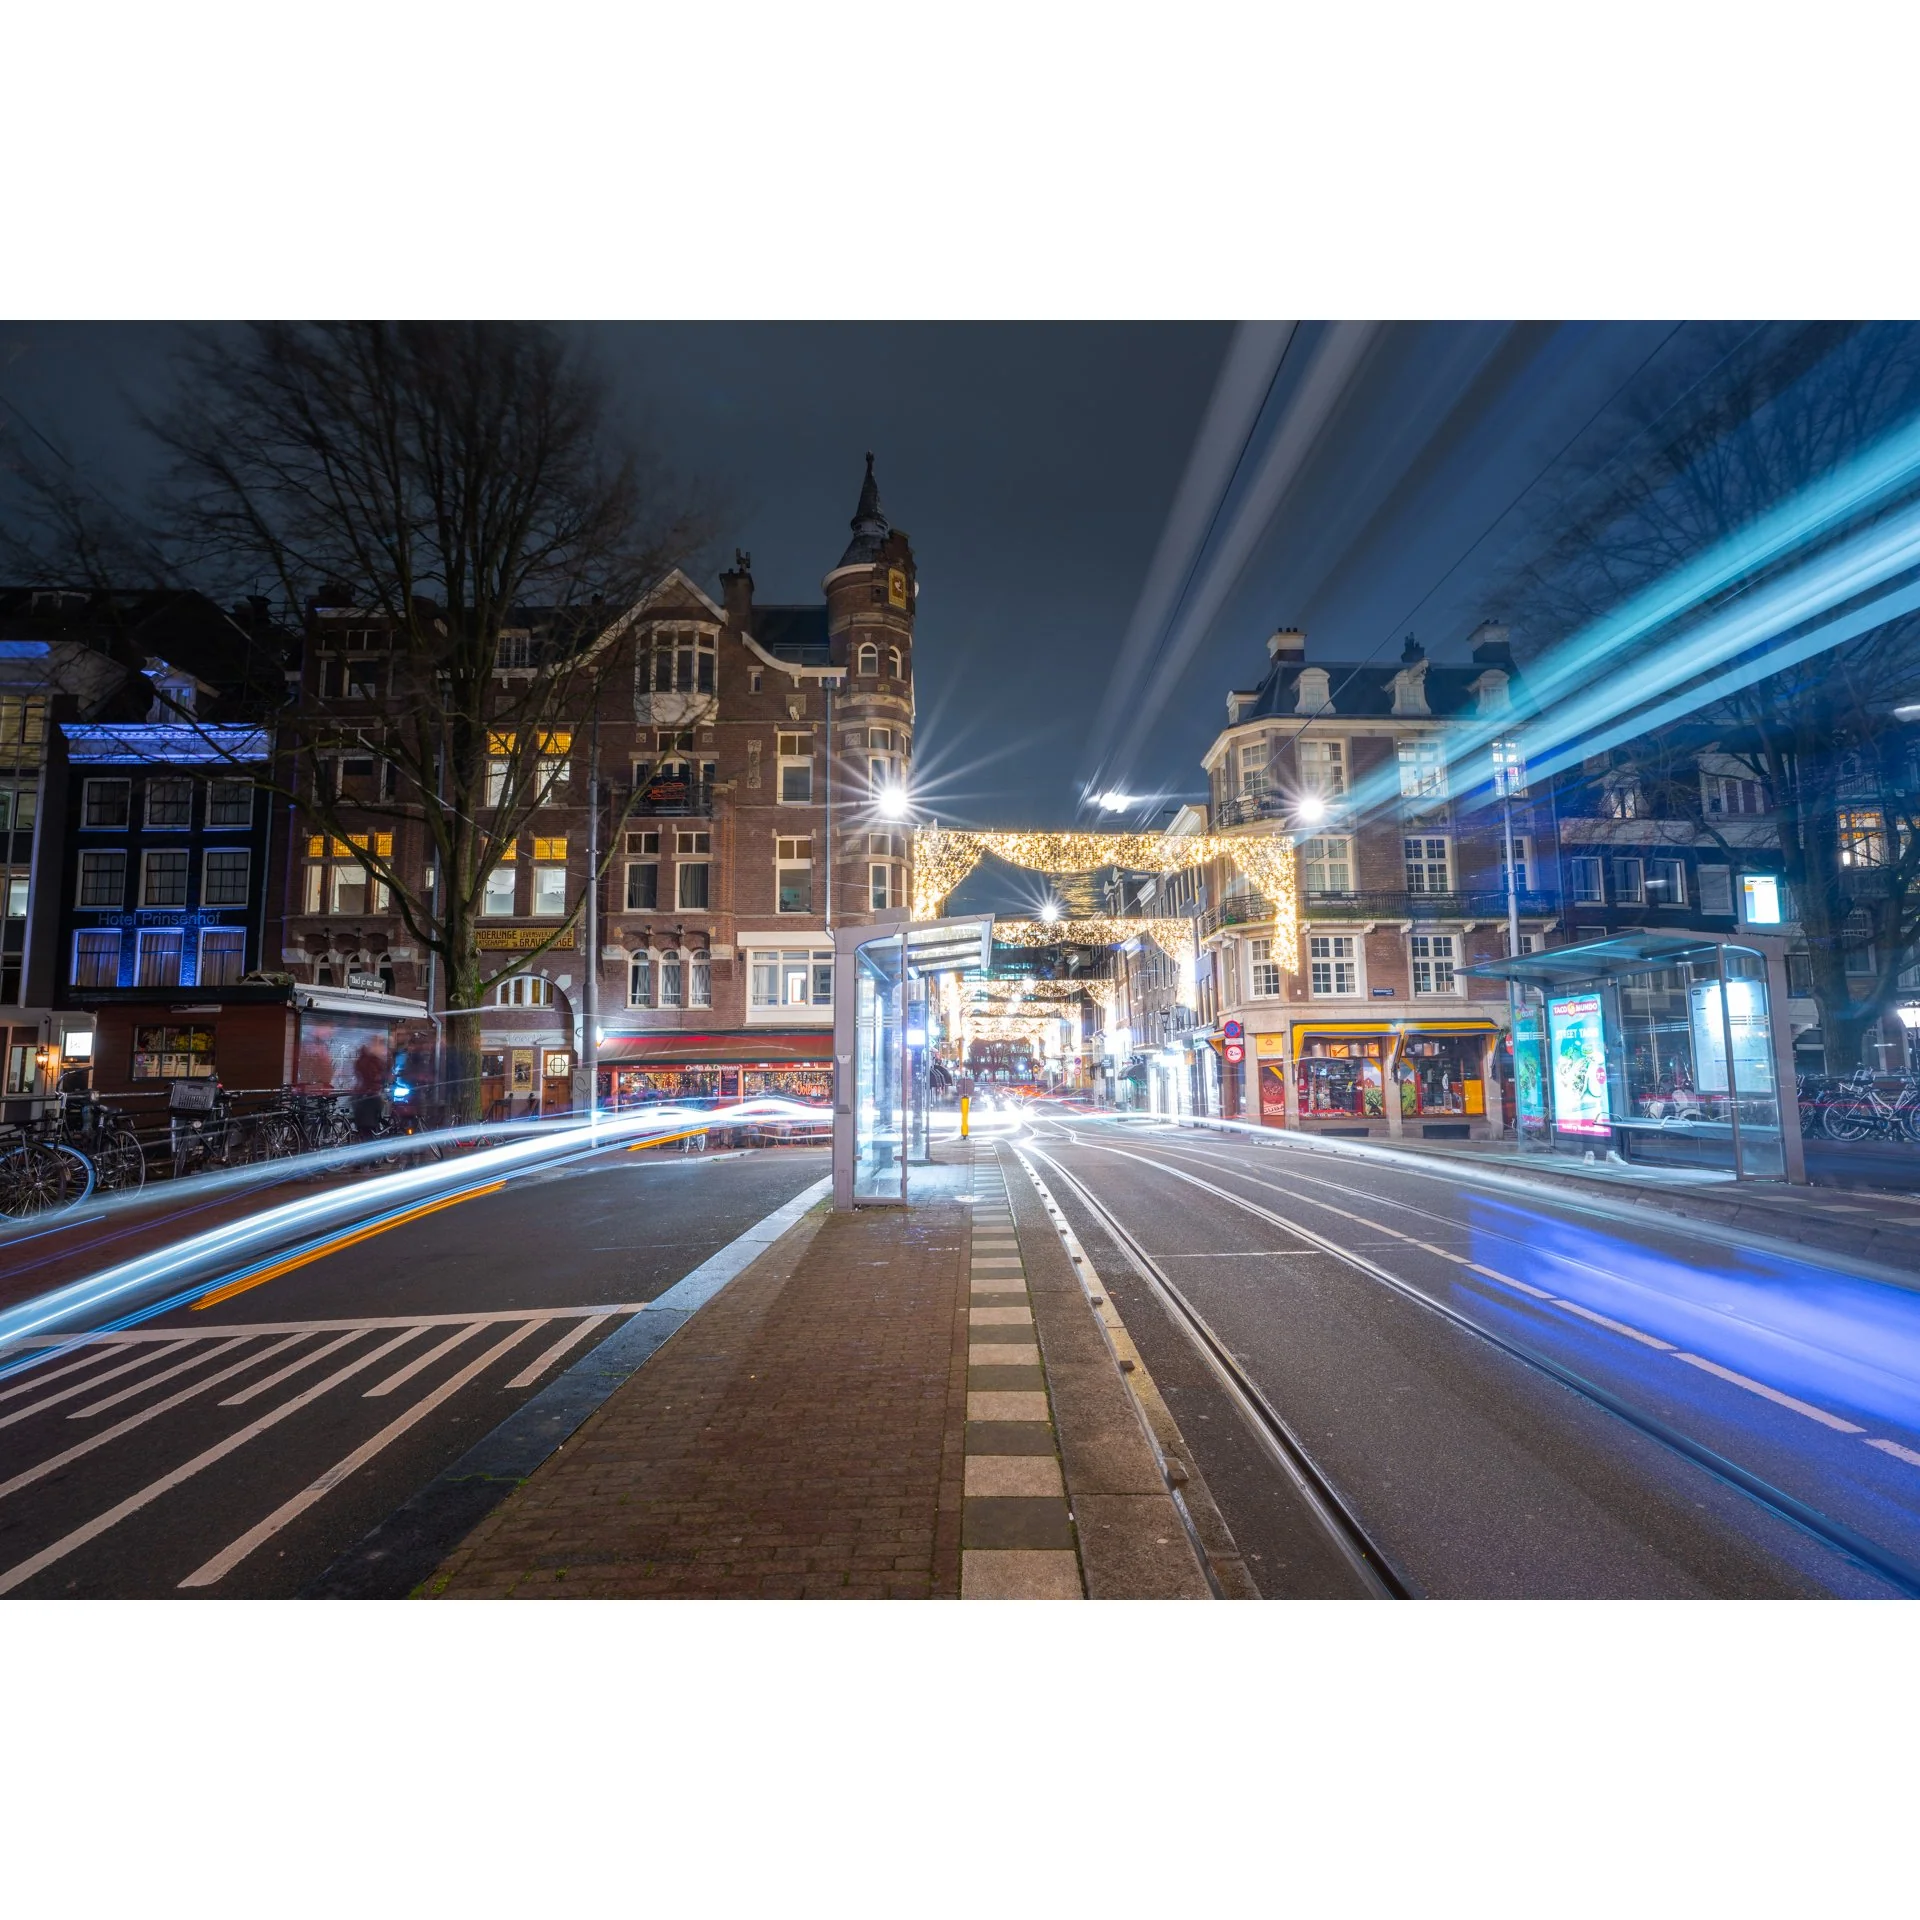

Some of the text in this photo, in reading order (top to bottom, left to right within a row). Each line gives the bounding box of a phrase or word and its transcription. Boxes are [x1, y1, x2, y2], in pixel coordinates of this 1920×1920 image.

[98, 911, 221, 926] Hotel Prinsenhof
[1553, 1002, 1598, 1014] TACO MUNDO
